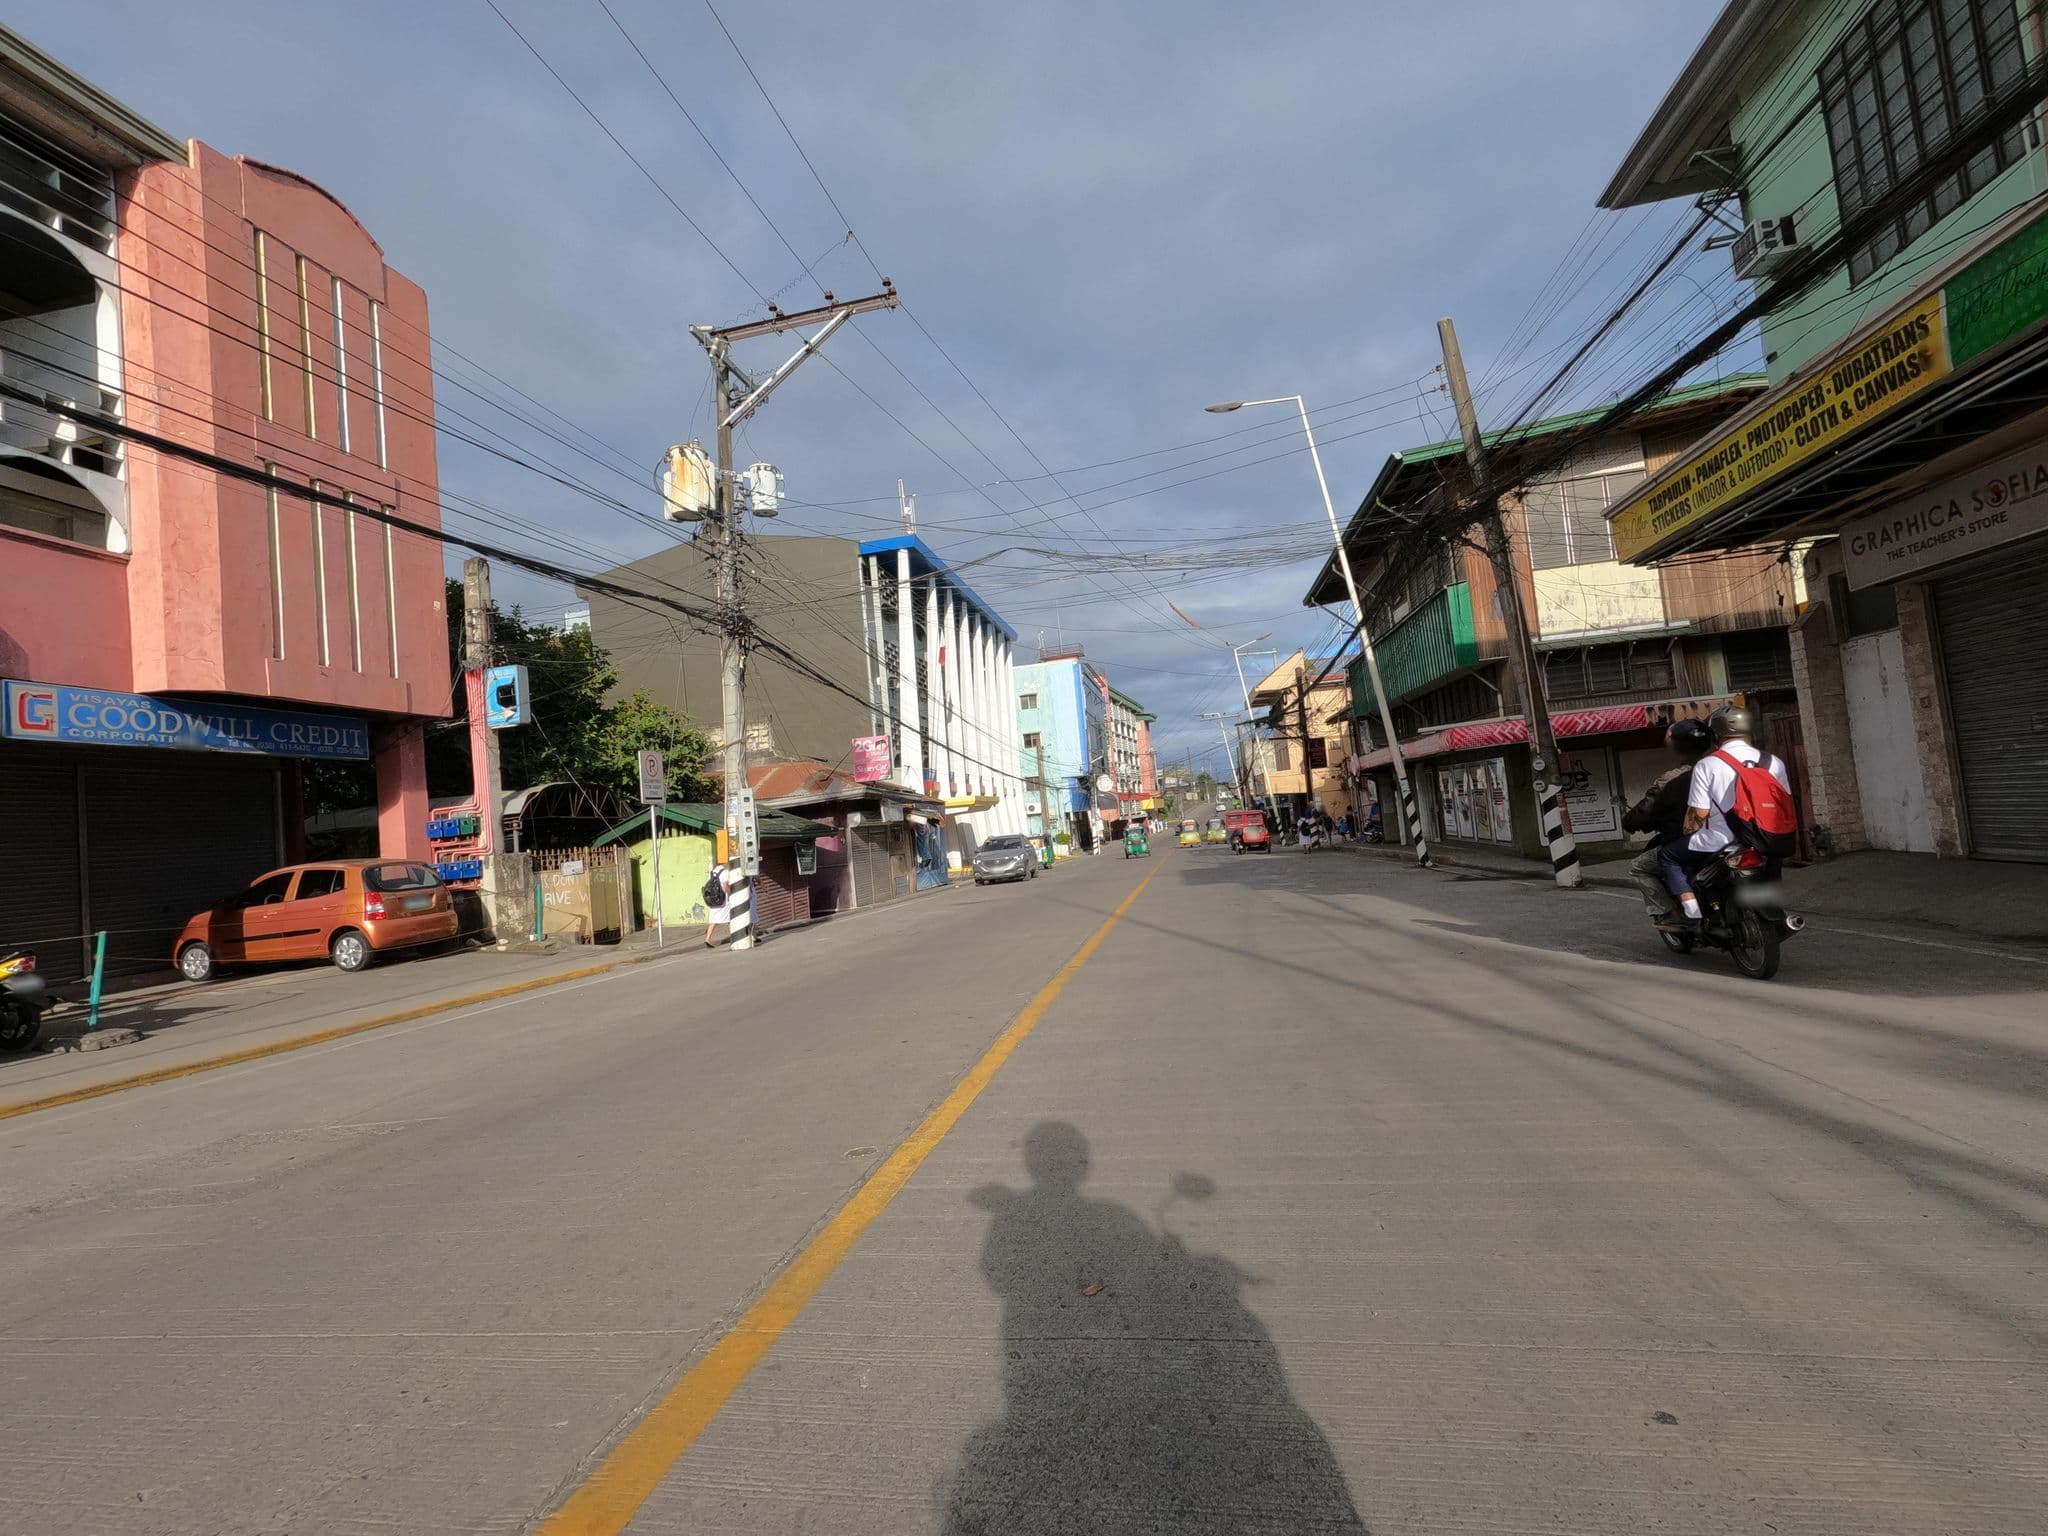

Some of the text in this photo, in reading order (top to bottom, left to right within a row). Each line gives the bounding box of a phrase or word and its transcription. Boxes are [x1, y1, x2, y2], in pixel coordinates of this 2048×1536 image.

[1648, 314, 1931, 514] TARPAULIN PANAFLEX PHOTOPAPER DURATRANS
[1652, 349, 1931, 534] STICKERS (INDOOR & OUTDOOR) CLOTH & CANVAS
[1851, 498, 1964, 556] GRAPHICA
[1887, 511, 2008, 561] THE TEACHER'S STORE
[69, 692, 152, 710] VISAYAS
[69, 703, 362, 749] GOODWILL CREDIT
[69, 728, 193, 746] CORPORATI
[545, 887, 571, 905] RIVE
